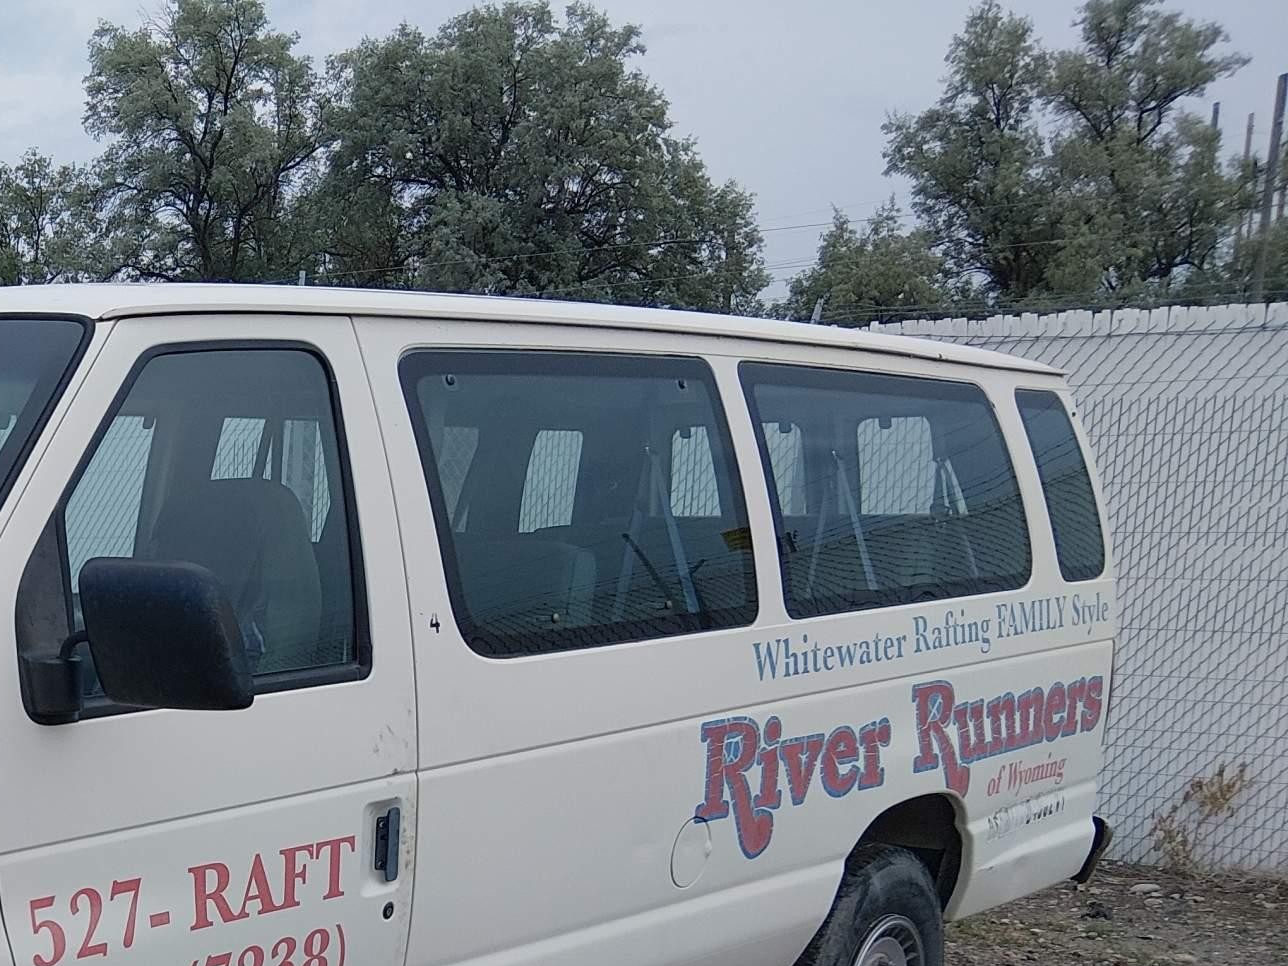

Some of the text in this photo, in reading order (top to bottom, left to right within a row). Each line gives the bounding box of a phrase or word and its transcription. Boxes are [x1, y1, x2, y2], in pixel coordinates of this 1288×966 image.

[753, 592, 1109, 681] Whitewater Rafting FAMILY Style
[694, 675, 1104, 859] River Runners
[987, 752, 1067, 797] of Wyoming
[188, 835, 356, 931] RAFT
